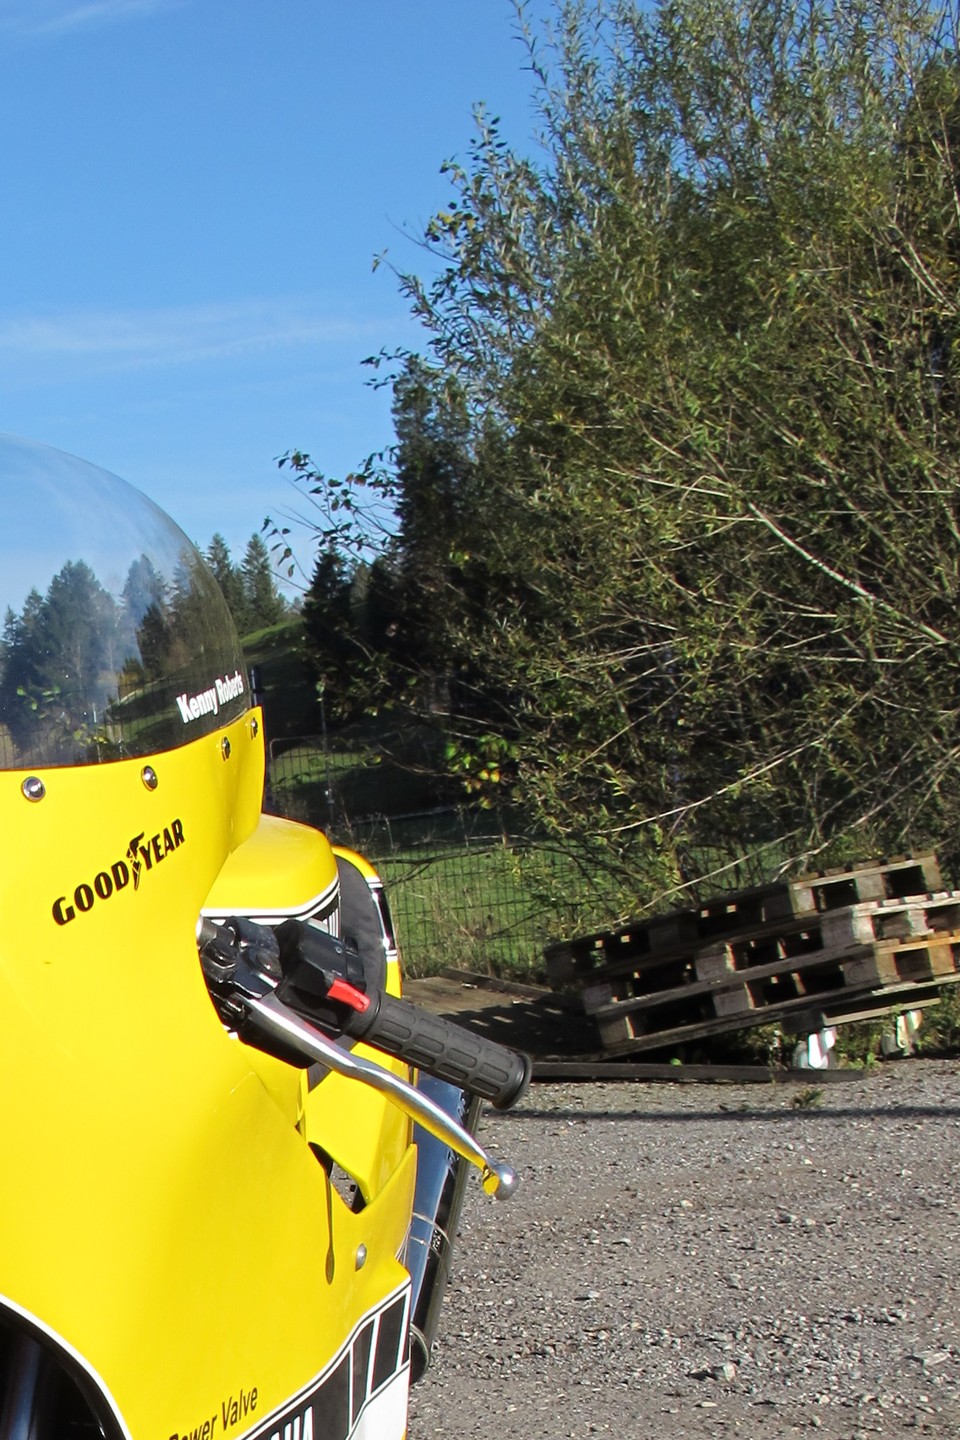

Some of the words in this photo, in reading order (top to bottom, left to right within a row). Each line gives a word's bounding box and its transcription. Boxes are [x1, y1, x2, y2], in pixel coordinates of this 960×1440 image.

[176, 693, 218, 723] Kenny
[214, 670, 244, 706] Roberts
[51, 818, 186, 927] GOODYEAR
[221, 1386, 258, 1431] Valve
